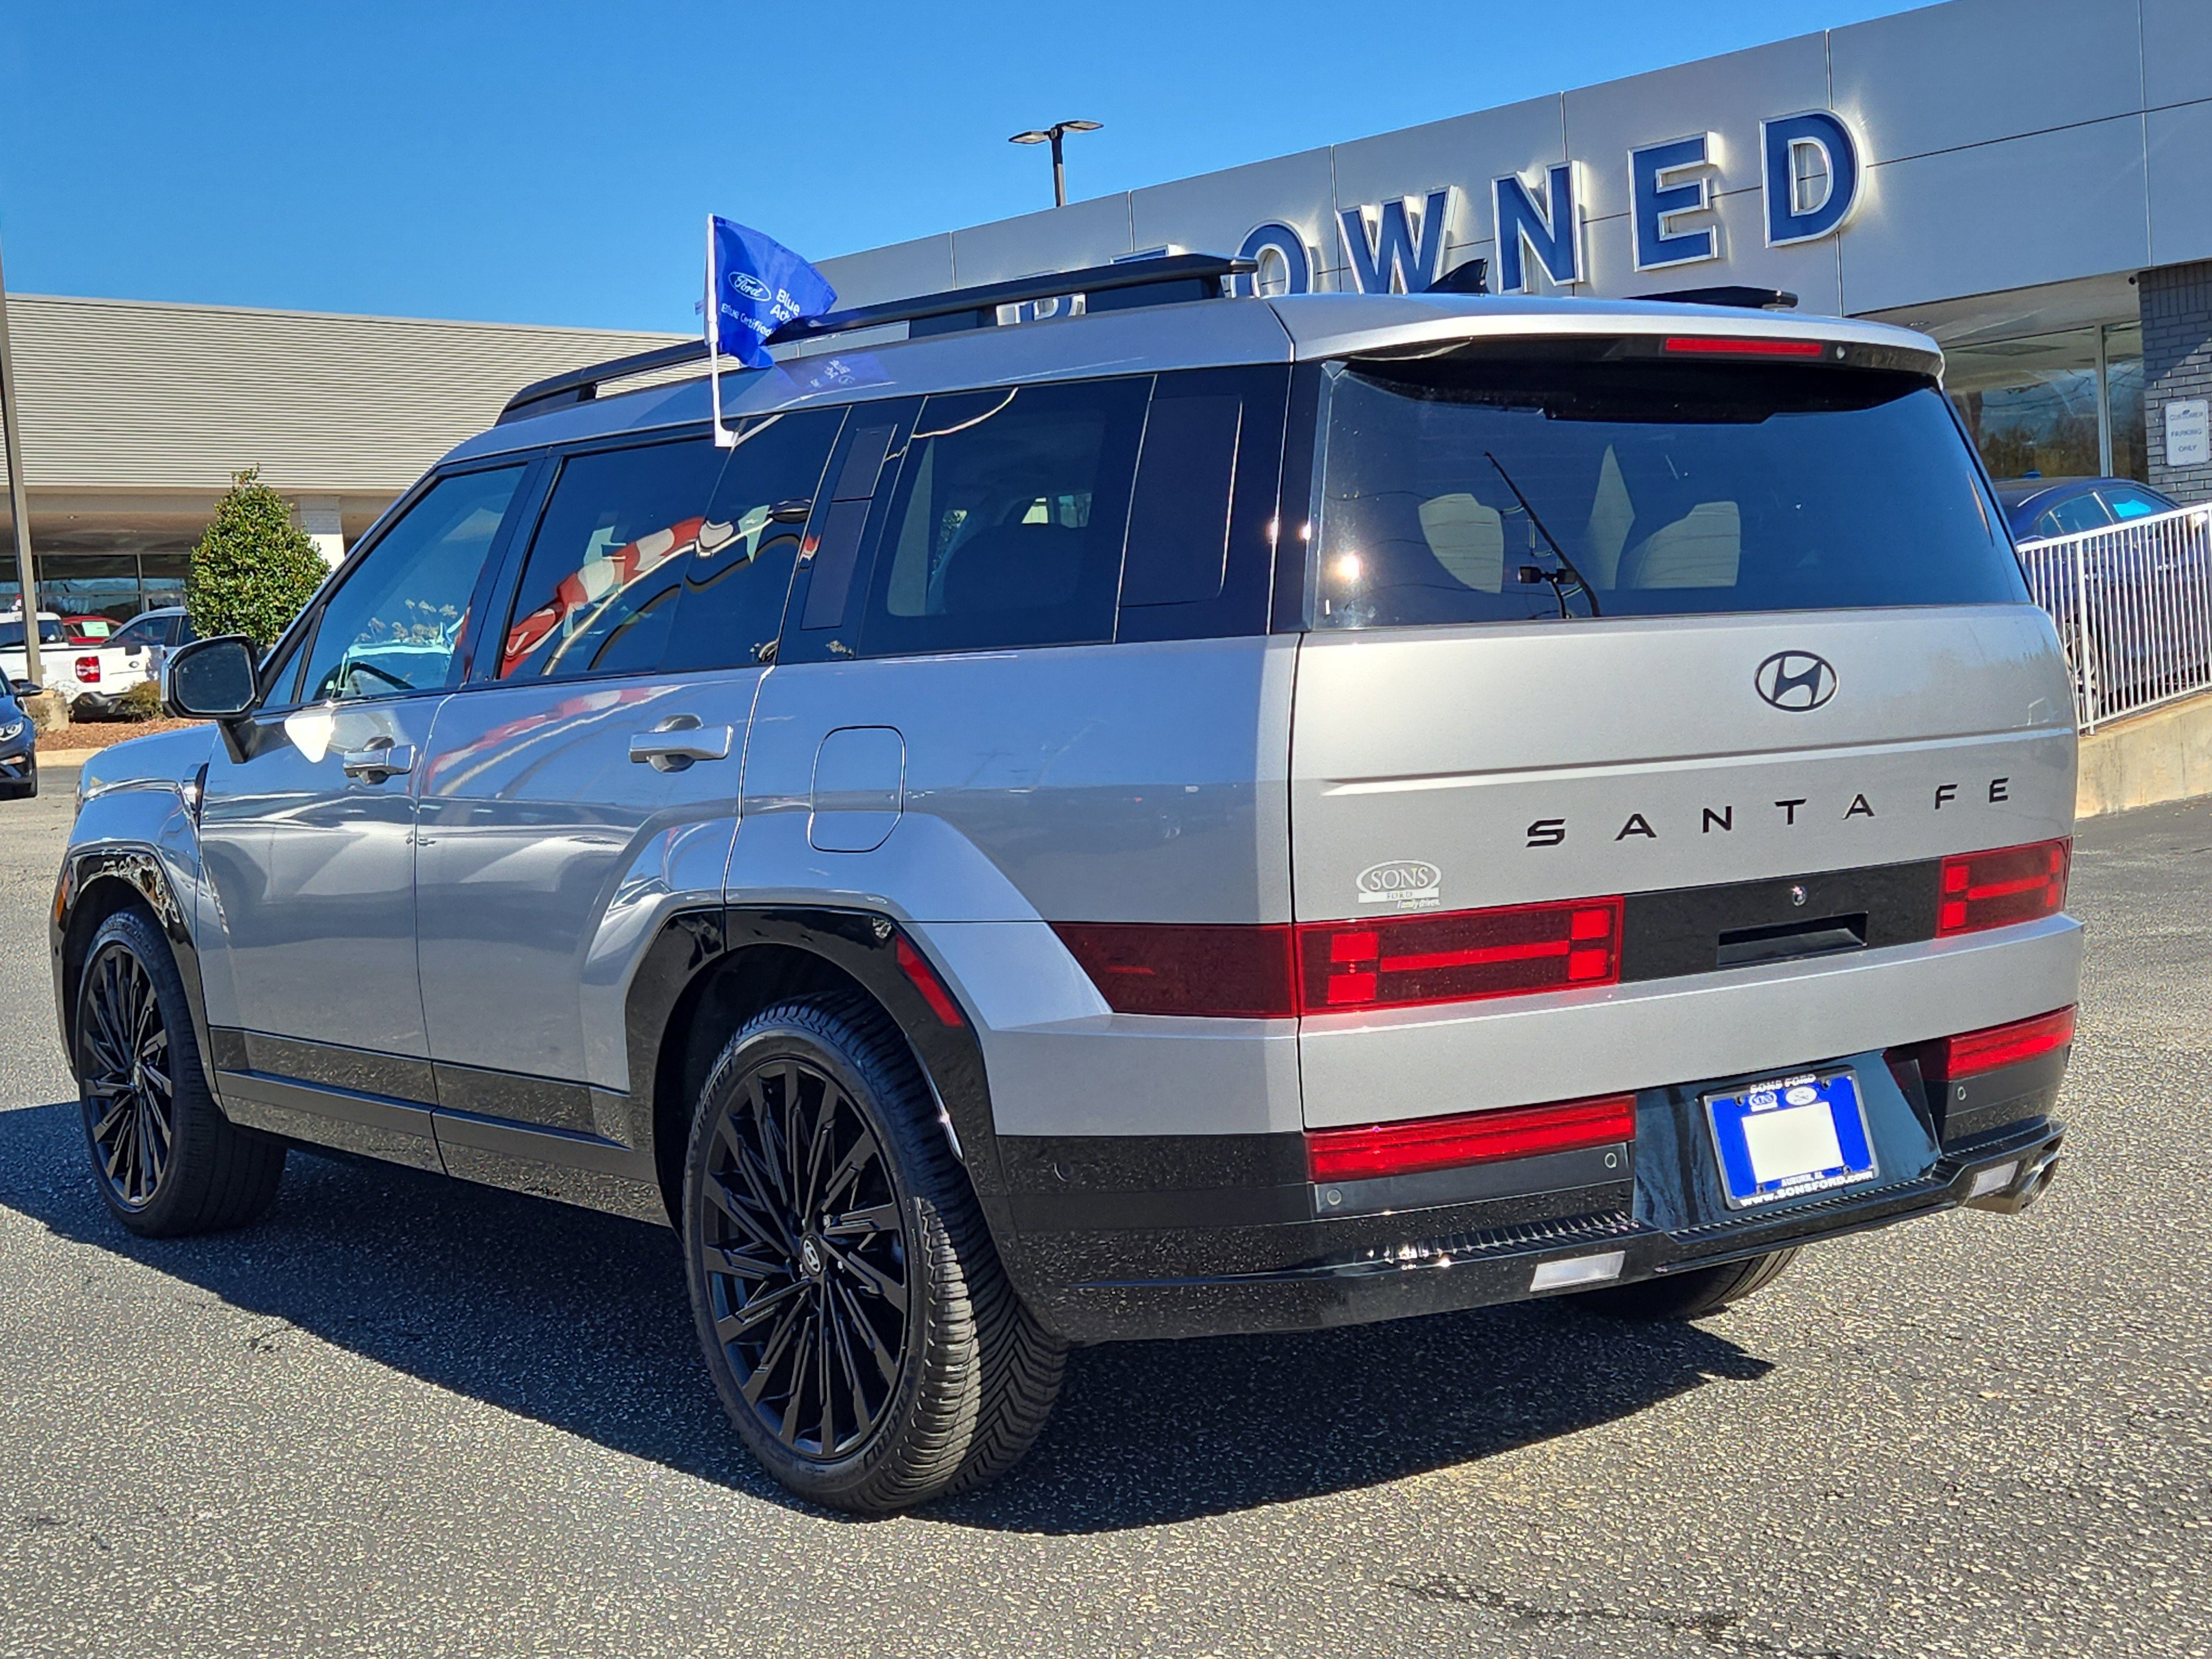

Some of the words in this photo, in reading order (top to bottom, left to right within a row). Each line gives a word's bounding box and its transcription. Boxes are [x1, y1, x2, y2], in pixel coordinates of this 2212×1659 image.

[732, 274, 765, 298] Ford
[721, 303, 739, 319] Blue
[776, 288, 800, 317] Blue
[2171, 428, 2202, 437] PARKING
[1525, 794, 1875, 848] SANTA
[1934, 777, 2009, 810] FE
[1370, 867, 1428, 890] SONS
[1750, 1080, 1783, 1094] SONS
[1785, 1073, 1816, 1088] FORD
